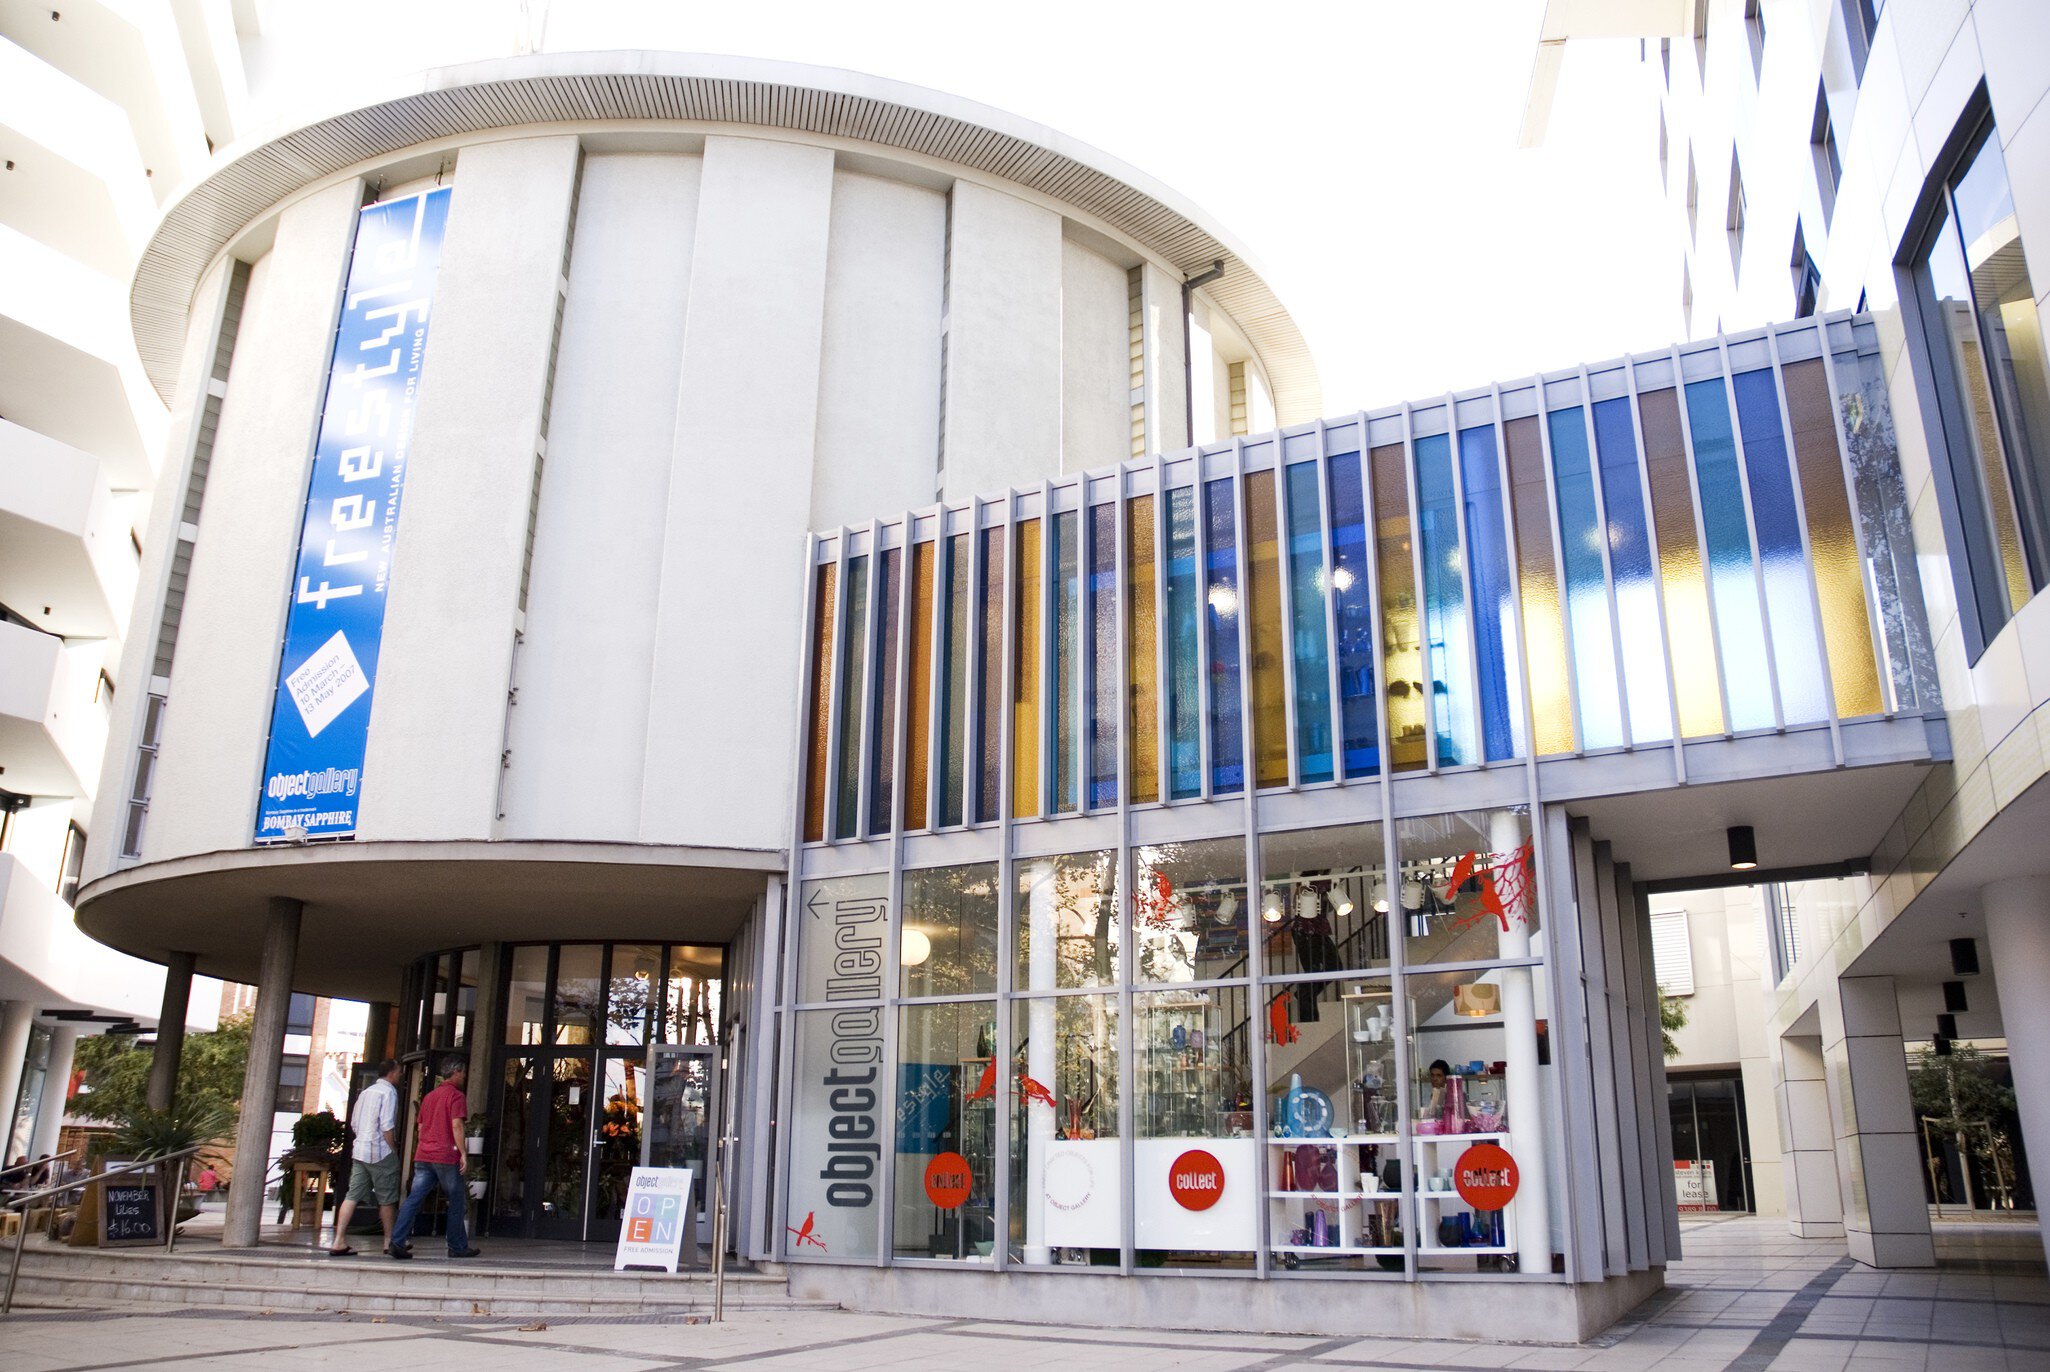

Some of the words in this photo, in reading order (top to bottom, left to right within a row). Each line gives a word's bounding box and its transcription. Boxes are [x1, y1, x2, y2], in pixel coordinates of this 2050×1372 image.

[408, 328, 425, 373] LIVING
[297, 194, 430, 610] freestyle
[403, 376, 417, 403] FOR
[381, 465, 403, 554] AUSTRALIAN
[374, 560, 387, 593] NEW
[290, 668, 311, 688] Free
[296, 655, 340, 697] Admission
[300, 694, 310, 706] 10
[310, 669, 339, 696] March
[304, 703, 315, 715] 13
[314, 686, 335, 706] May
[334, 665, 355, 688] 2007
[267, 767, 359, 802] objectgallery
[261, 813, 305, 832] BOMBAY
[303, 810, 353, 828] SAPPHIRE
[820, 897, 889, 1208] objectgallery
[1176, 1171, 1217, 1190] collect
[1463, 1167, 1511, 1187] collect
[1687, 1180, 1701, 1189] for
[108, 1190, 150, 1203] NOVEMBER
[1682, 1190, 1709, 1199] lease
[108, 1218, 151, 1237] $16.00
